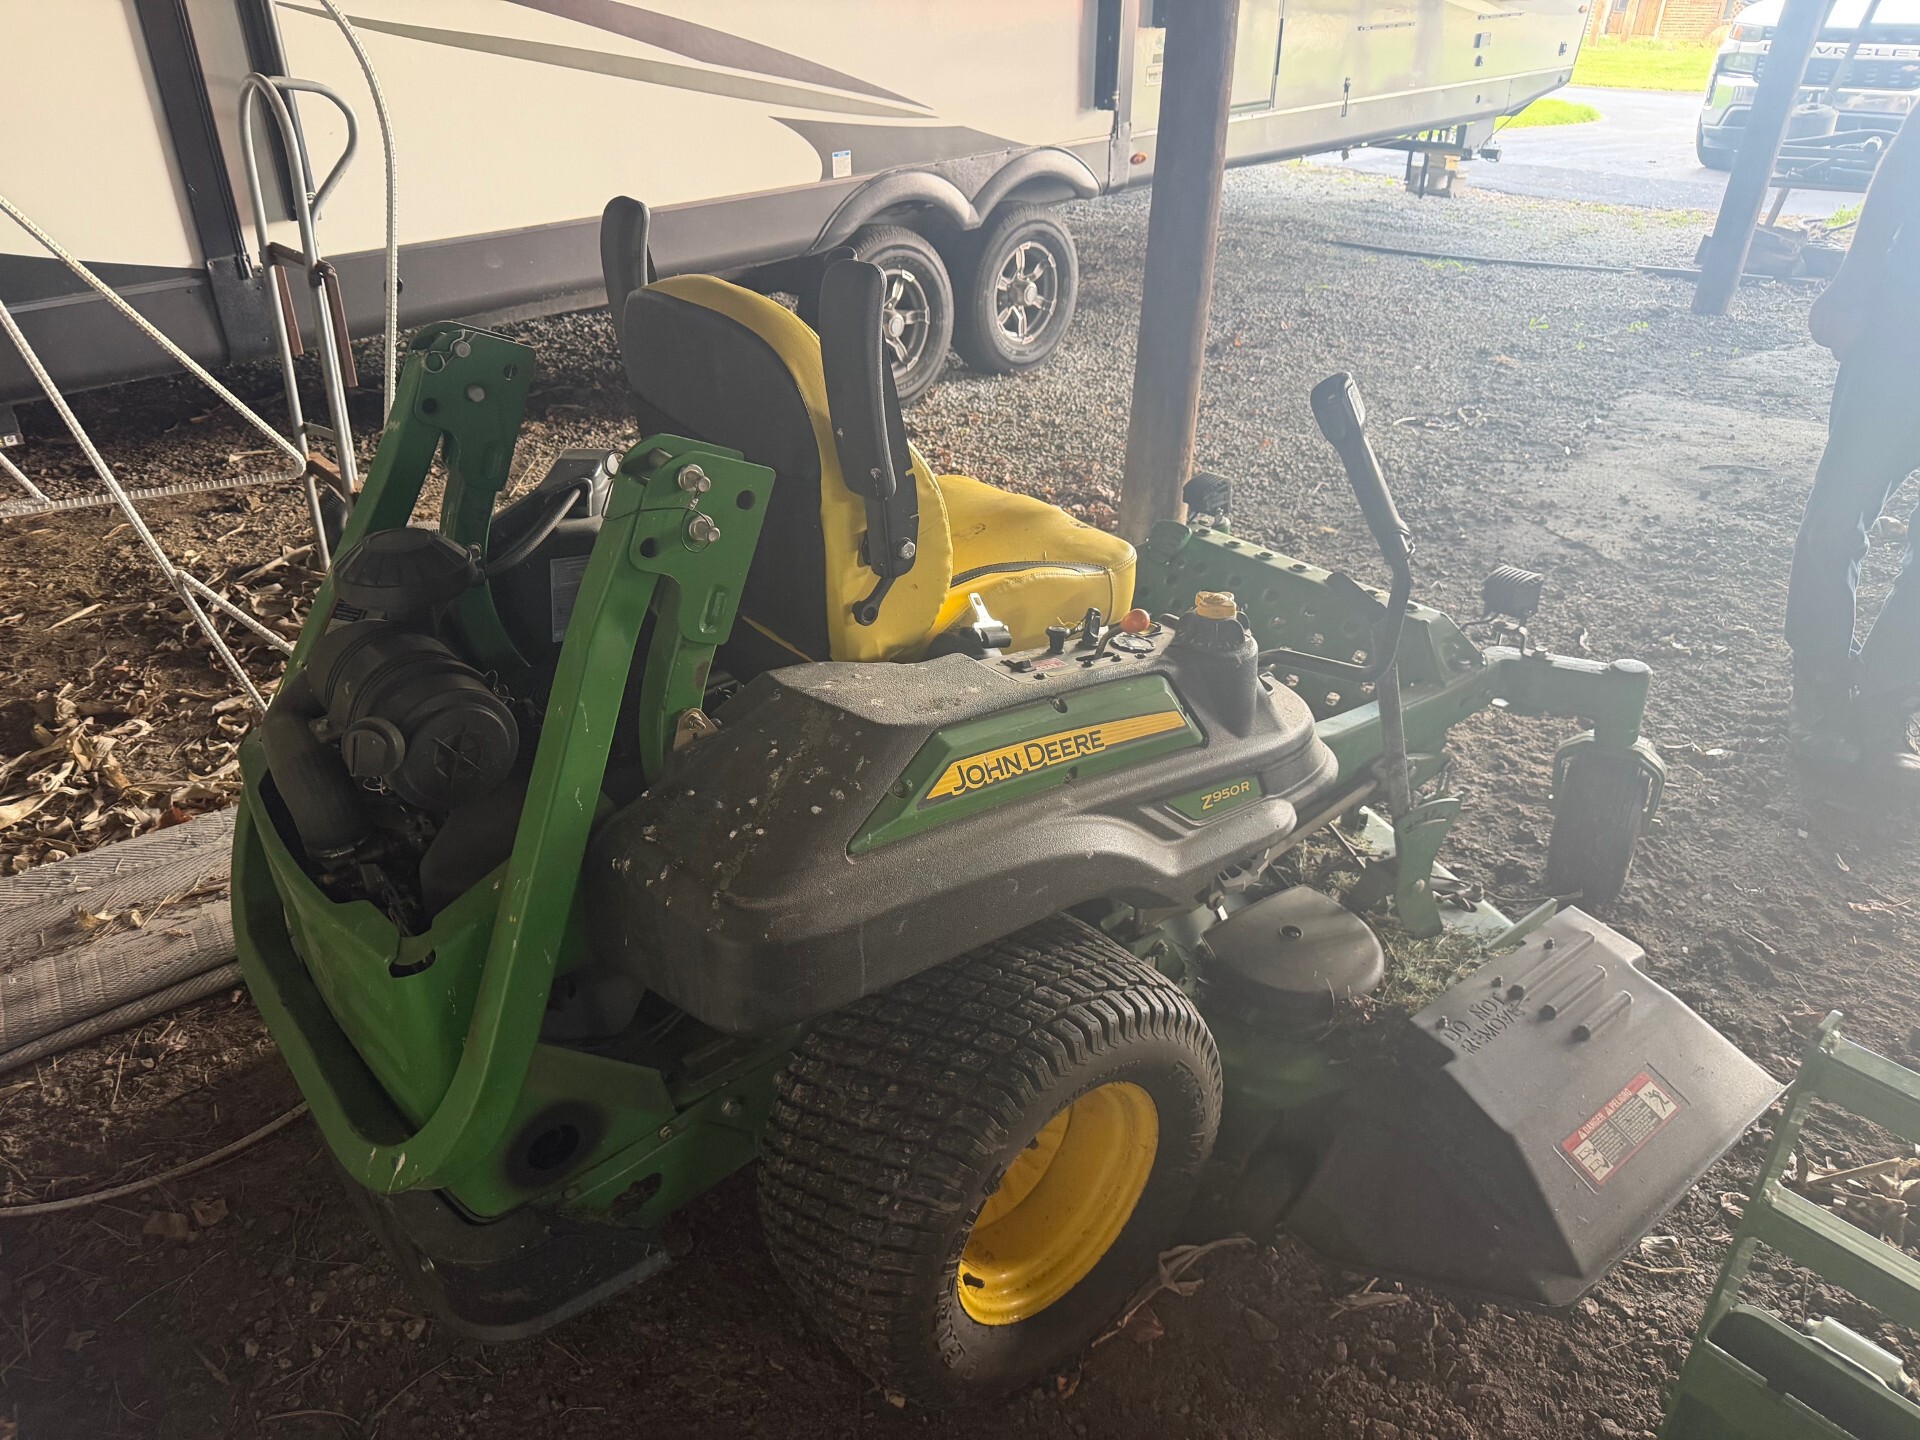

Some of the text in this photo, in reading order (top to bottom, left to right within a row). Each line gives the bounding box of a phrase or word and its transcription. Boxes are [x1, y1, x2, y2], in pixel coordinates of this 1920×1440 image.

[953, 730, 1105, 792] JOHN DEERE
[1201, 780, 1251, 811] Z950R
[1444, 992, 1505, 1041] DO NOT
[1461, 1003, 1526, 1055] REMOVE
[1582, 1112, 1607, 1134] DANGER
[1609, 1087, 1633, 1111] PELIGRO
